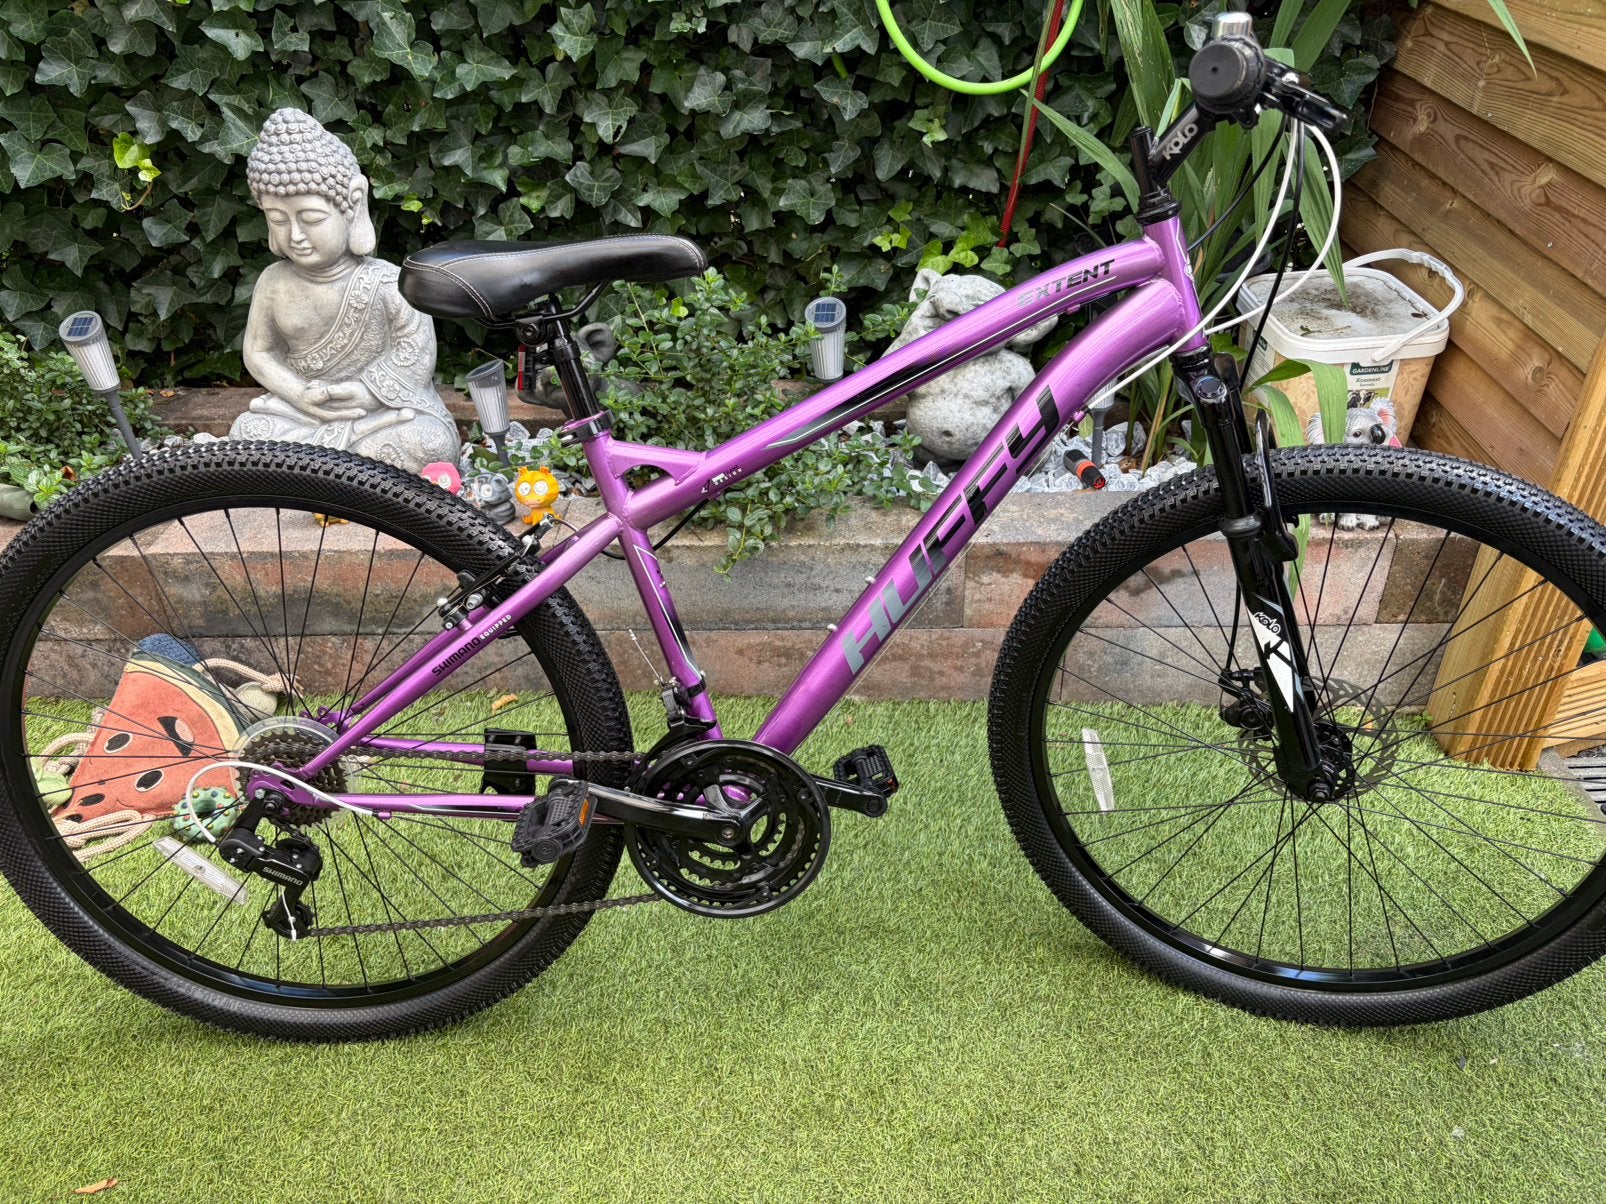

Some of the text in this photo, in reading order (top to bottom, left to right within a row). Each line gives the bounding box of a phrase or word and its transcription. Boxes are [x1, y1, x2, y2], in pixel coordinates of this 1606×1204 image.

[1017, 258, 1116, 307] EXTENT
[842, 385, 1060, 675] HUFFY
[431, 614, 512, 676] SHIMANO EQUIPPED
[262, 866, 304, 886] SHIMANO
